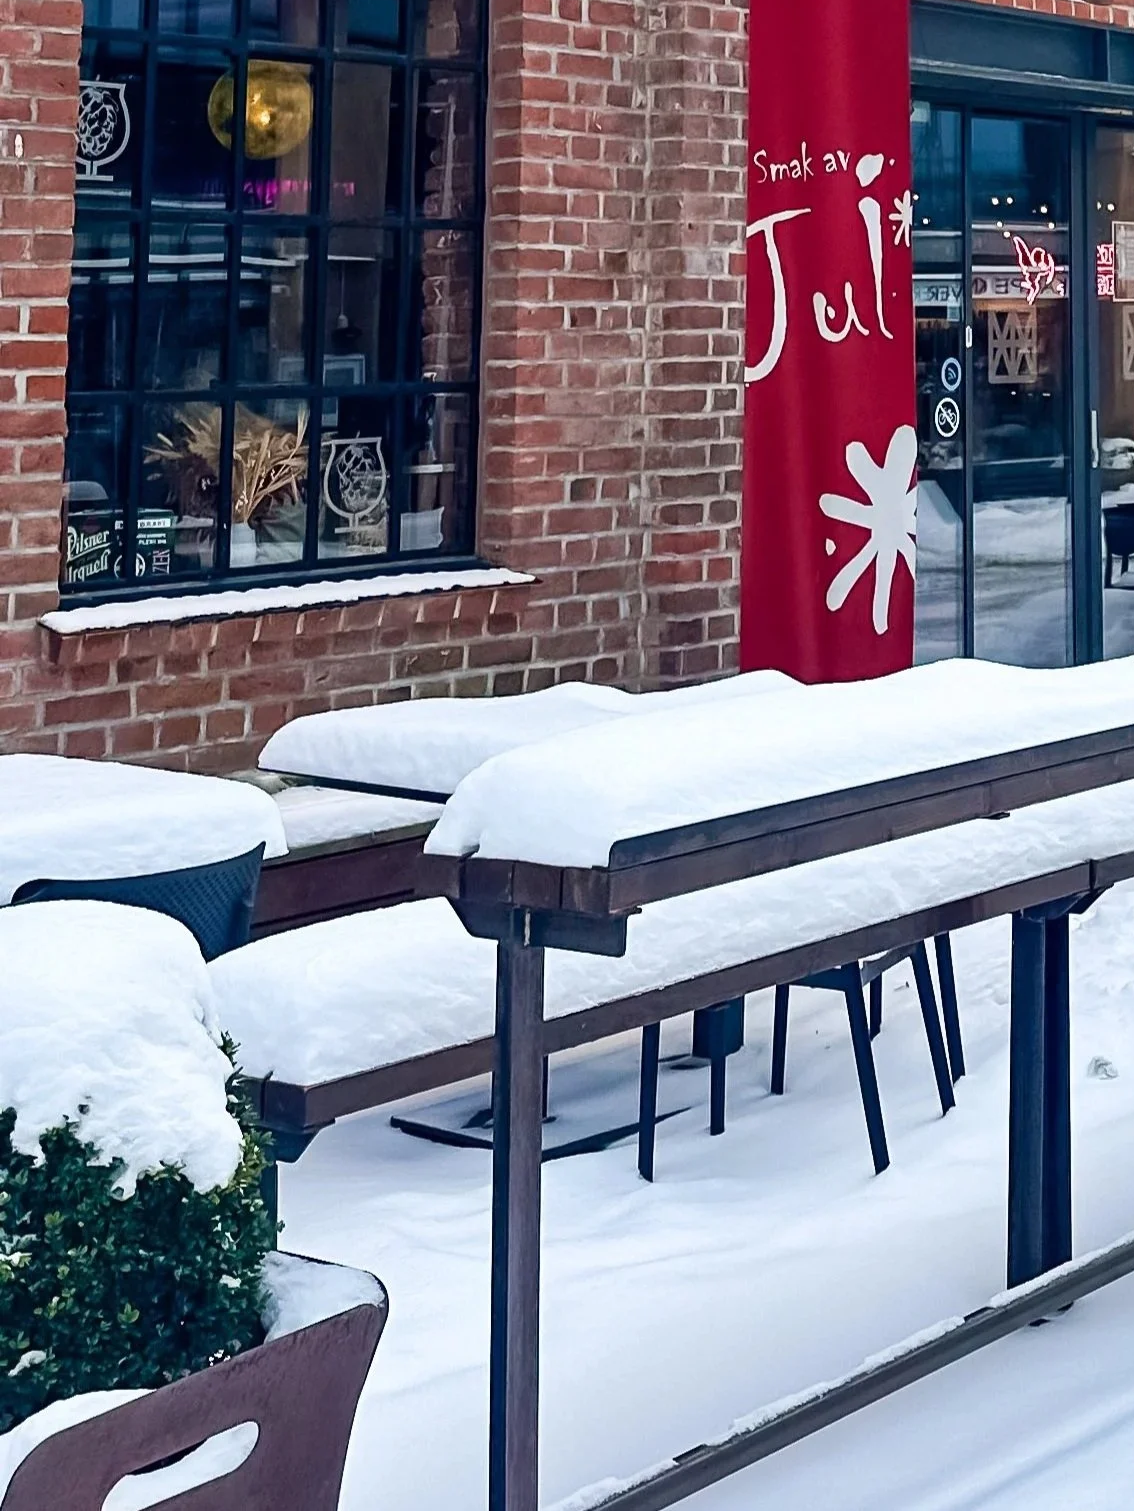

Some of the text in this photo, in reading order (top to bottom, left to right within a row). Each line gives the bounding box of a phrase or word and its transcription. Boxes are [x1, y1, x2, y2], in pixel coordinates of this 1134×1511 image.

[753, 141, 850, 183] Smak av
[744, 195, 894, 383] Jul
[67, 526, 110, 556] Pilsner
